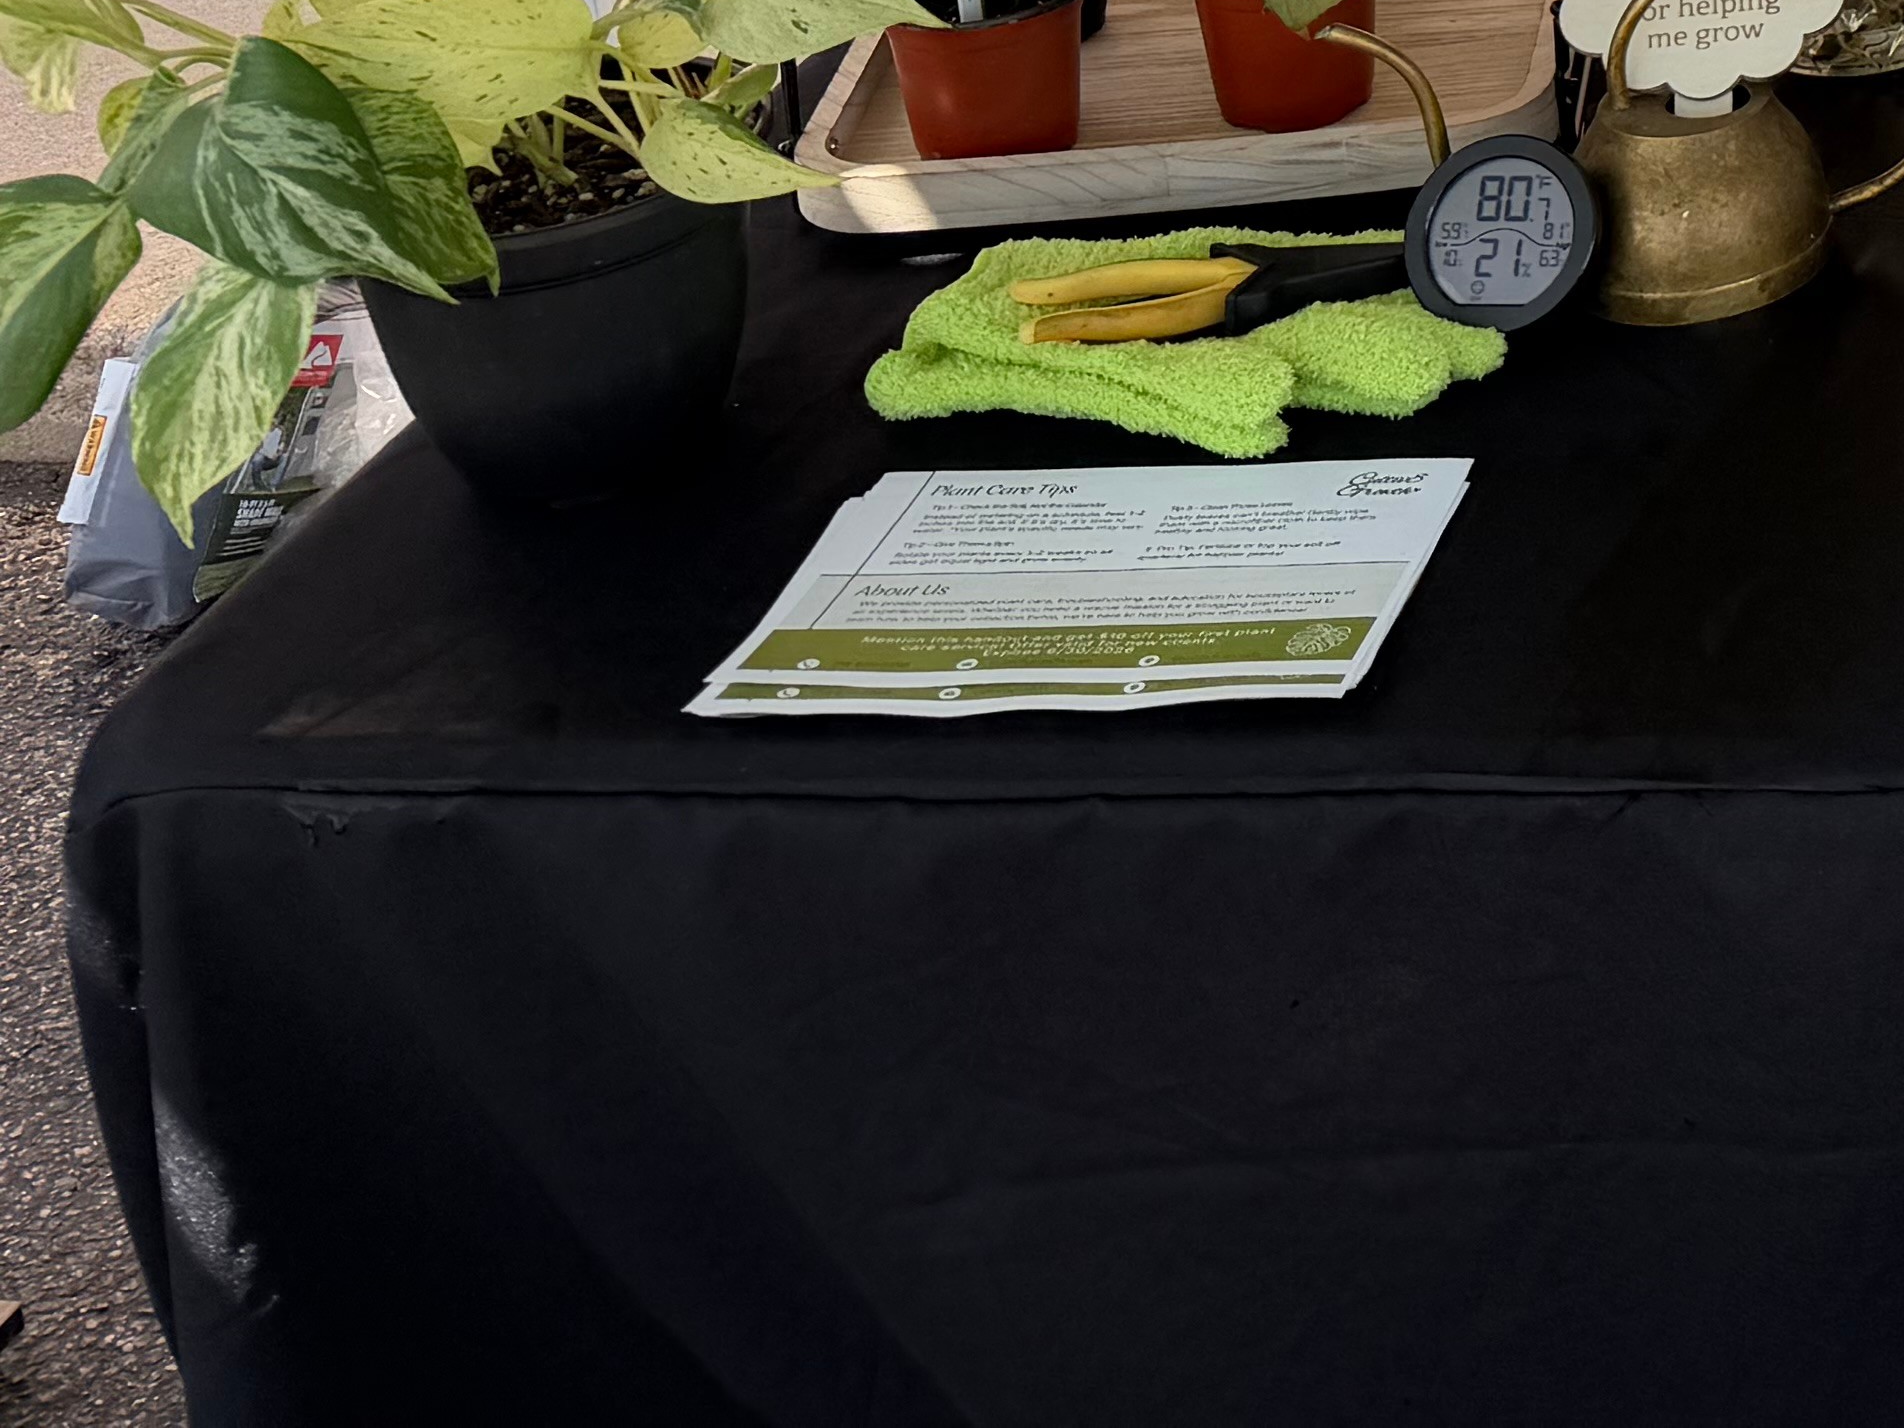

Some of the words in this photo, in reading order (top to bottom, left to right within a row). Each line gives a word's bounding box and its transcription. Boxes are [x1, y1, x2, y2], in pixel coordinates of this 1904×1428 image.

[1641, 3, 1671, 22] or
[1647, 31, 1688, 49] me
[1695, 22, 1765, 50] grow
[930, 484, 983, 496] Plant
[985, 484, 1035, 496] Care
[853, 583, 919, 596] About
[921, 583, 951, 595] Us
